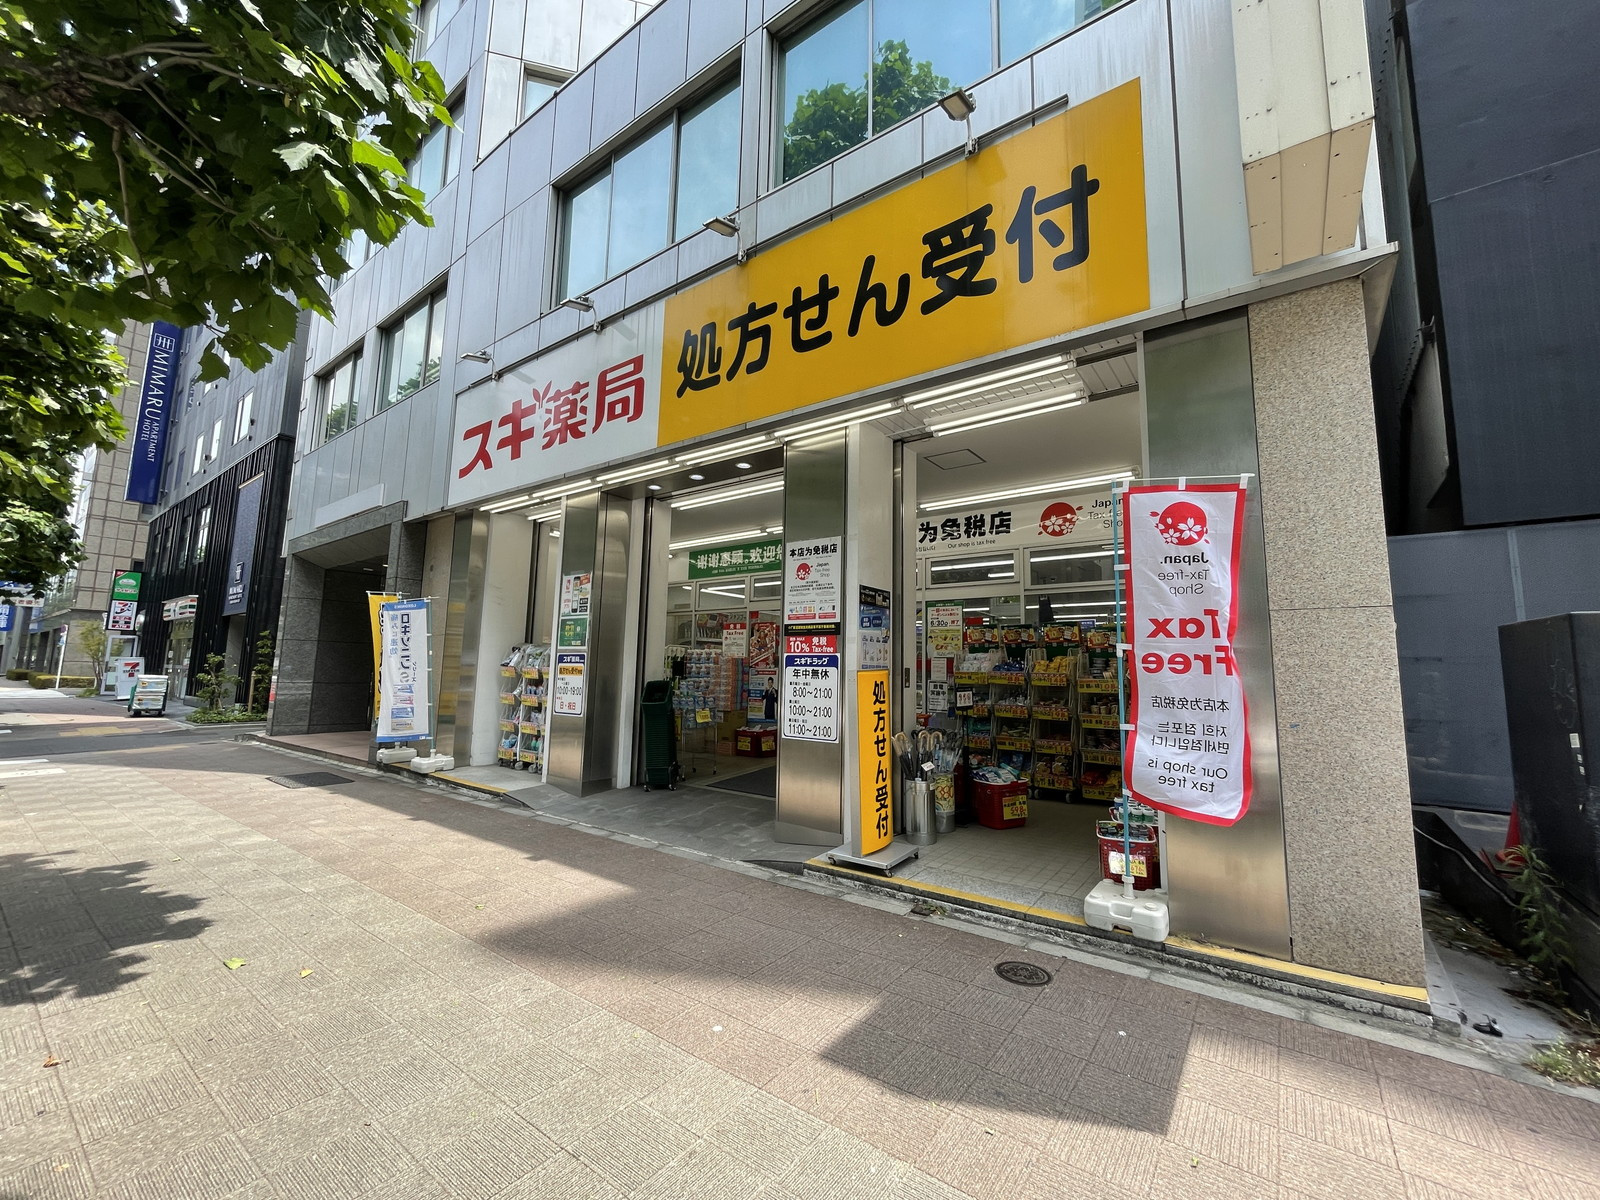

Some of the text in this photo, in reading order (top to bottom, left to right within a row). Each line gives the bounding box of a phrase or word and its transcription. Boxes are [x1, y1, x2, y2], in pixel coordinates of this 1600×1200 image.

[676, 164, 1099, 398] 処方せん受付
[145, 349, 169, 421] MIMARU
[459, 353, 645, 479] スギ薬局
[141, 419, 160, 462] APARTMENT HOTEL
[789, 543, 837, 558] 本店为免税店
[790, 641, 810, 652] 10%
[812, 636, 827, 645] 免税
[794, 657, 829, 665] スギドラッグ
[793, 669, 829, 680] 年中無休
[792, 687, 832, 699] 8:00～21:00
[789, 705, 832, 718] 10:00～21:00
[788, 724, 832, 738] 11:00～21:00
[872, 680, 889, 839] 処方せん受付
